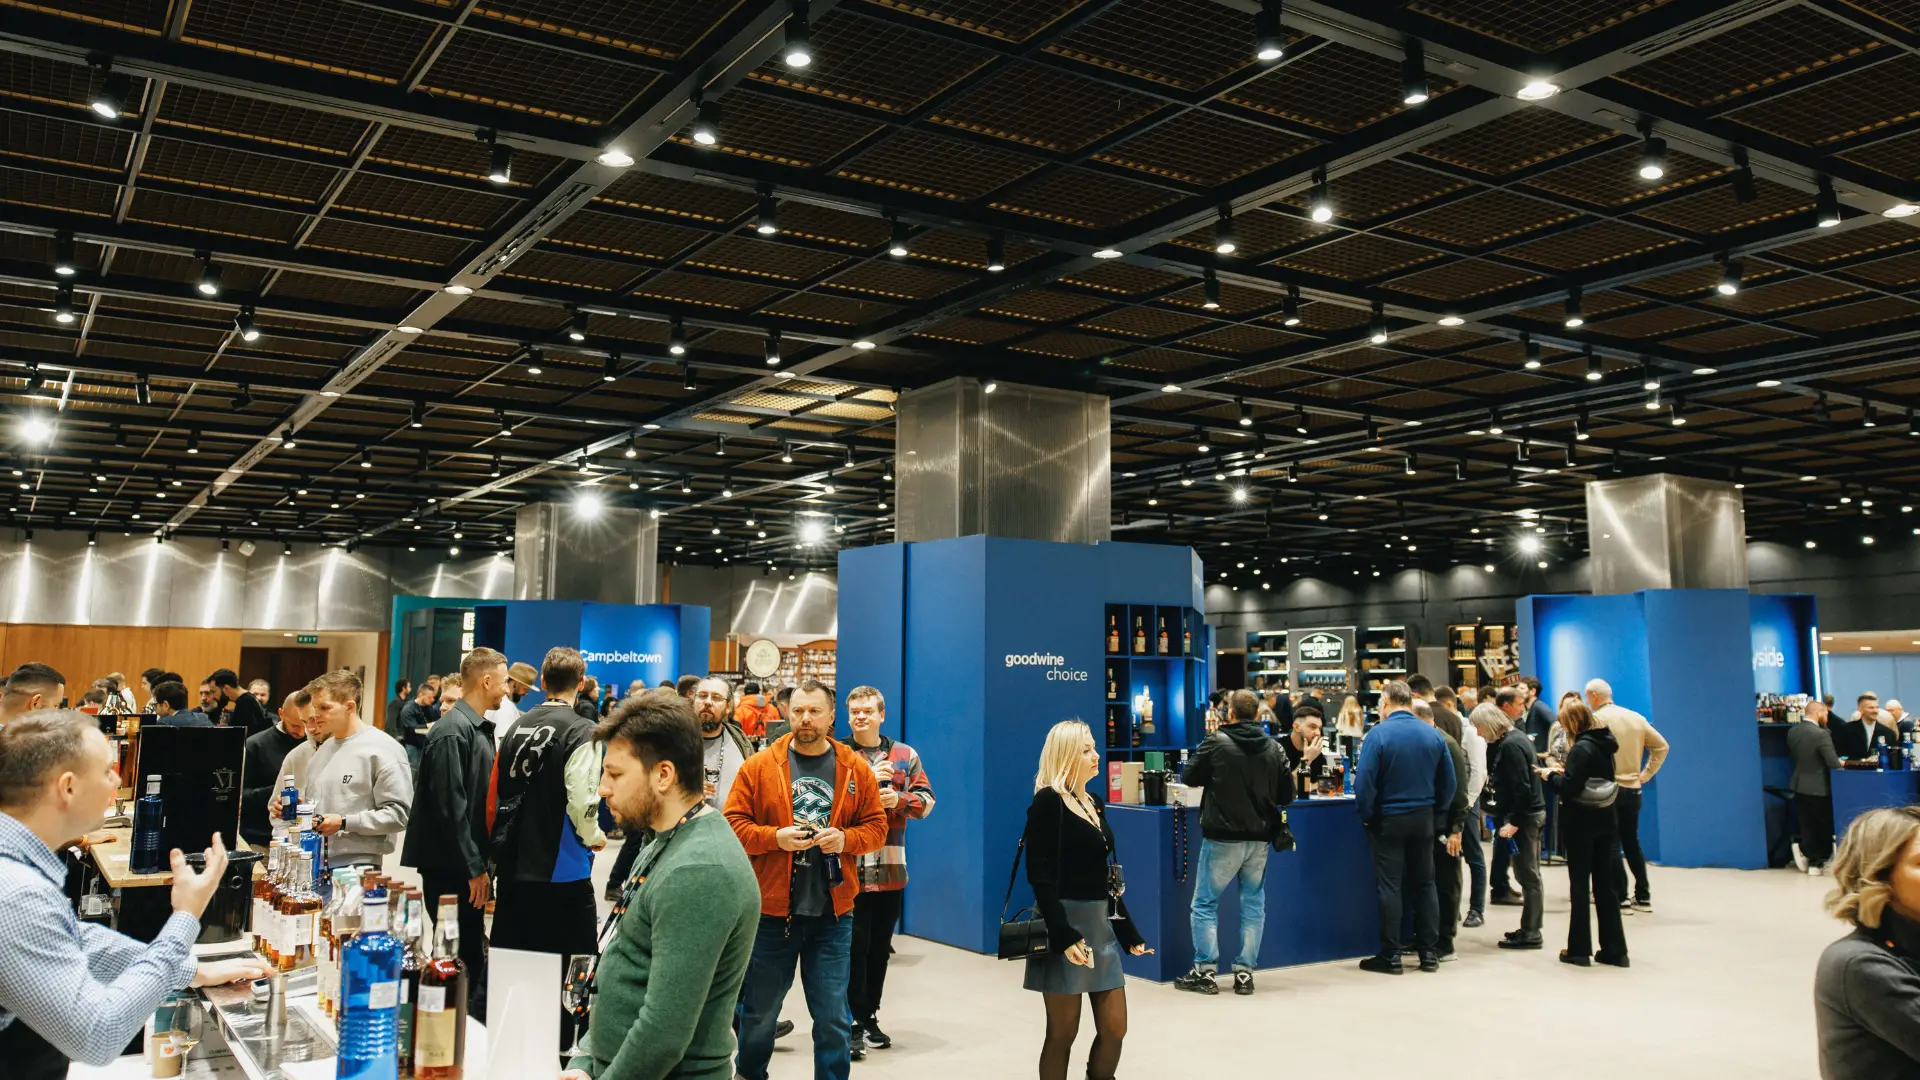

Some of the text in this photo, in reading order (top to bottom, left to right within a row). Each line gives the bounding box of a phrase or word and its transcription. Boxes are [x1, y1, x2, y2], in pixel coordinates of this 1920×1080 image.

[580, 650, 662, 664] Campbeltown
[1005, 652, 1064, 667] goodwine
[1046, 666, 1088, 681] choice
[509, 725, 556, 778] 73
[342, 774, 353, 784] 87
